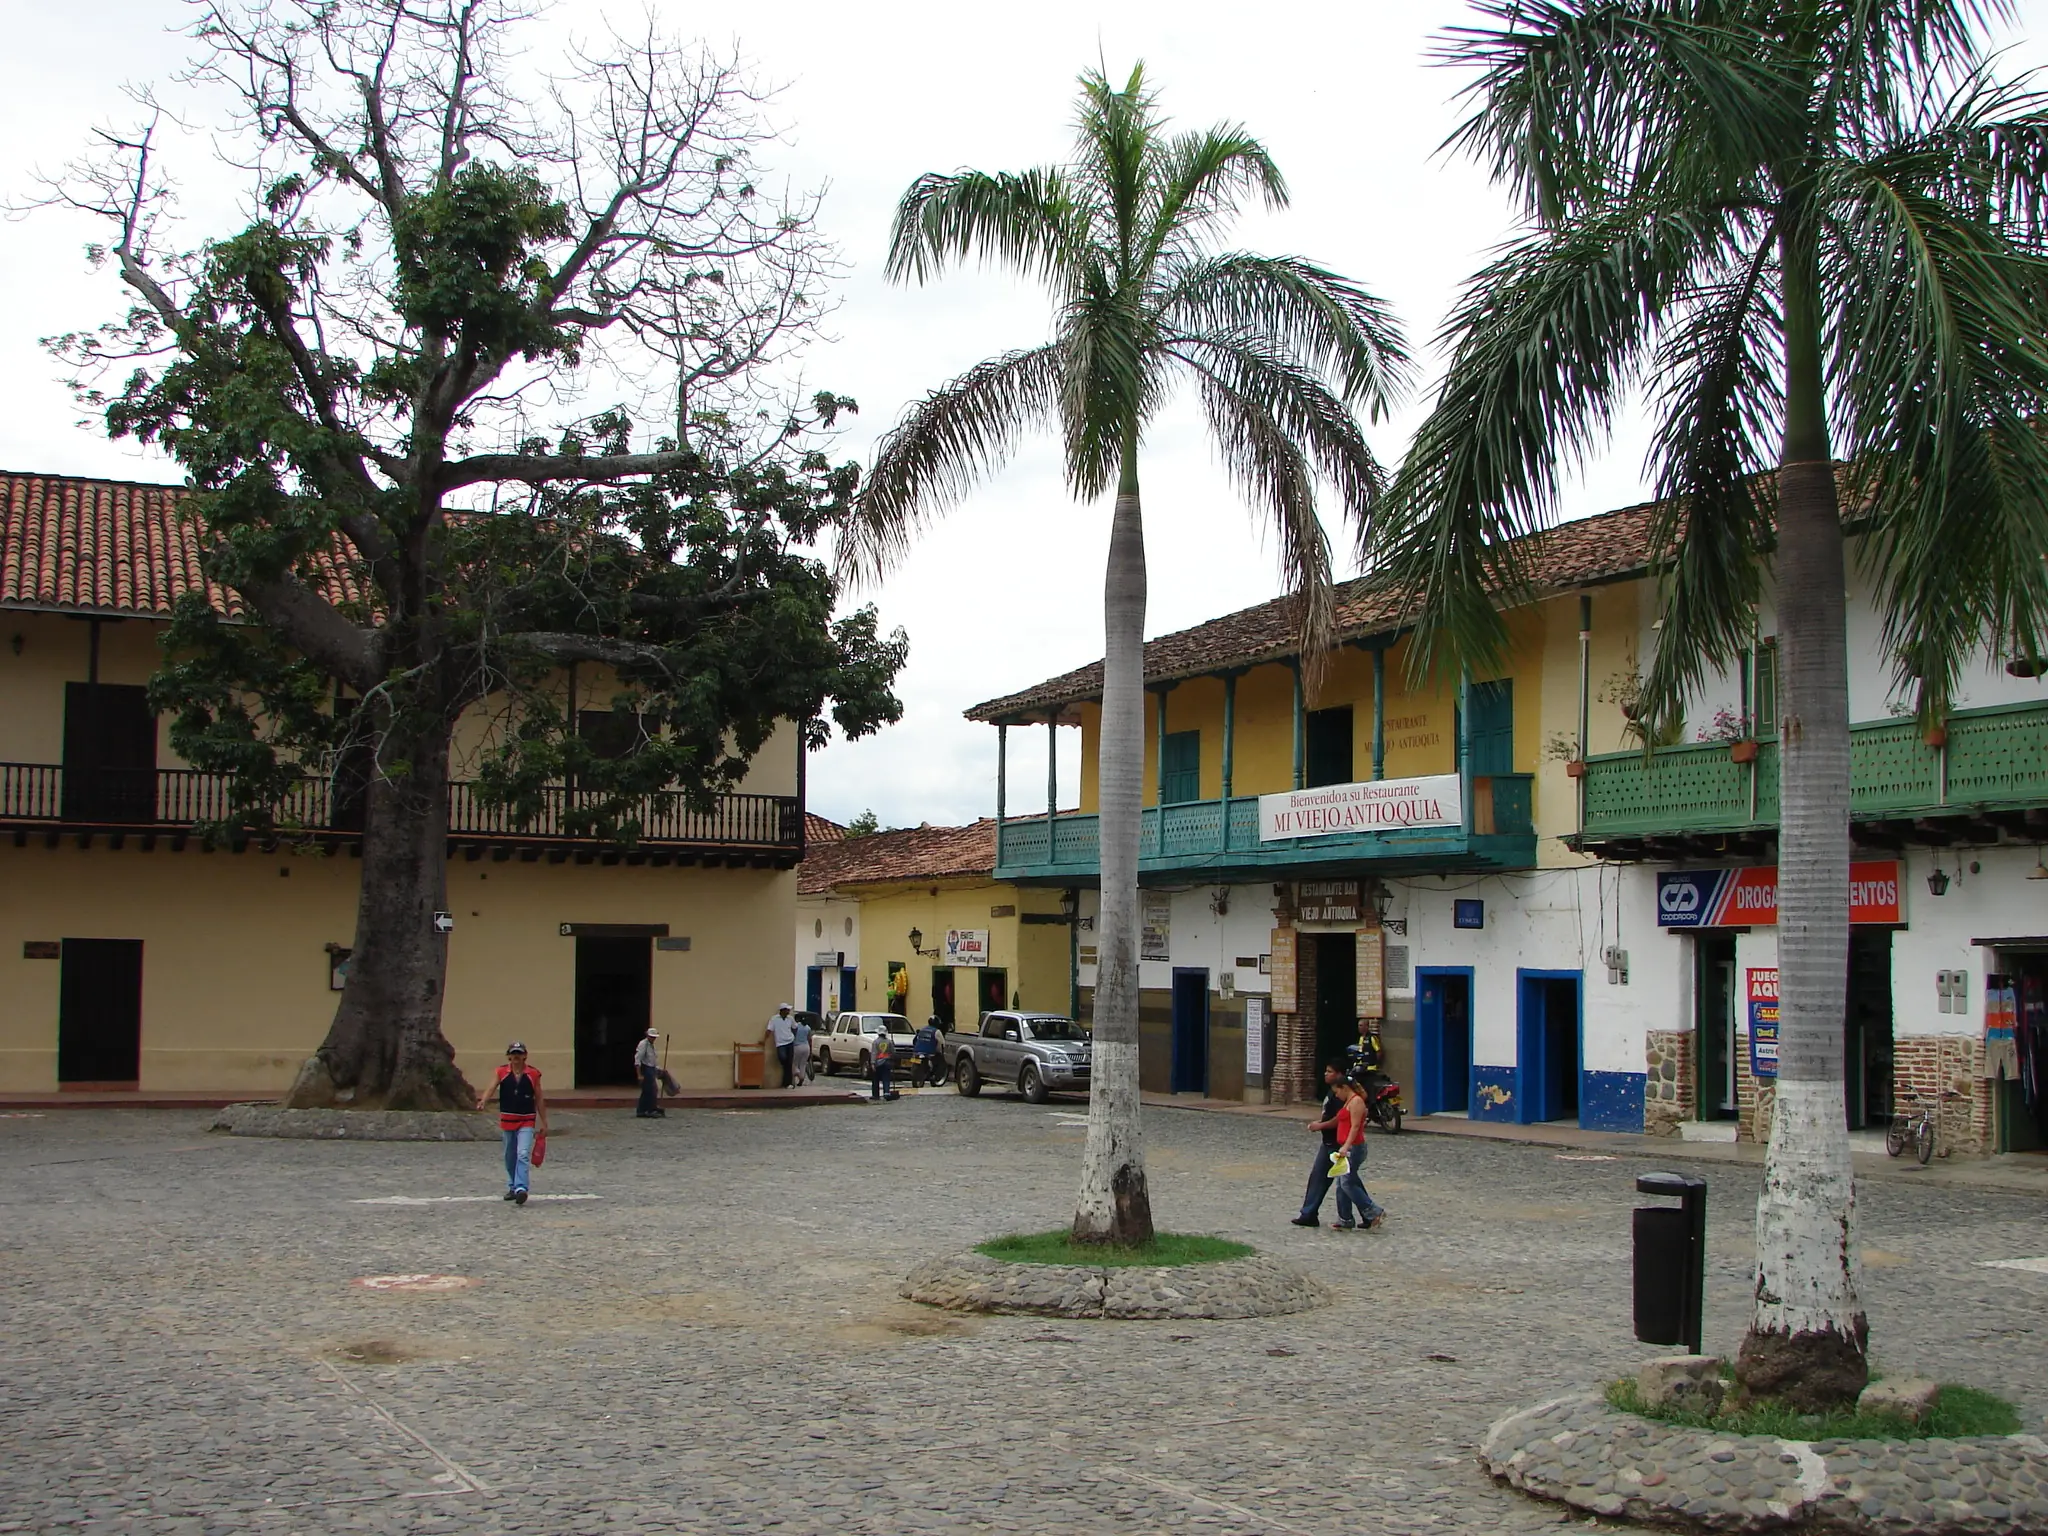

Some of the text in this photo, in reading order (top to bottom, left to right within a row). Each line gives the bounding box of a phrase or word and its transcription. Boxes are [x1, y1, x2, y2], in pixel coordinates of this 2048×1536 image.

[1400, 732, 1440, 750] ANTIOQUIA
[1350, 790, 1360, 802] su
[1363, 784, 1420, 800] Restaurante
[1274, 798, 1443, 833] MI VIEJO ANTIOQUIA
[1301, 883, 1343, 897] RESTAURANTE
[1849, 879, 1896, 906] ENTOS
[1301, 905, 1358, 921] VIEJO ANTIOQUIA
[1751, 971, 1779, 982] JUEG
[1751, 982, 1779, 998] AQU
